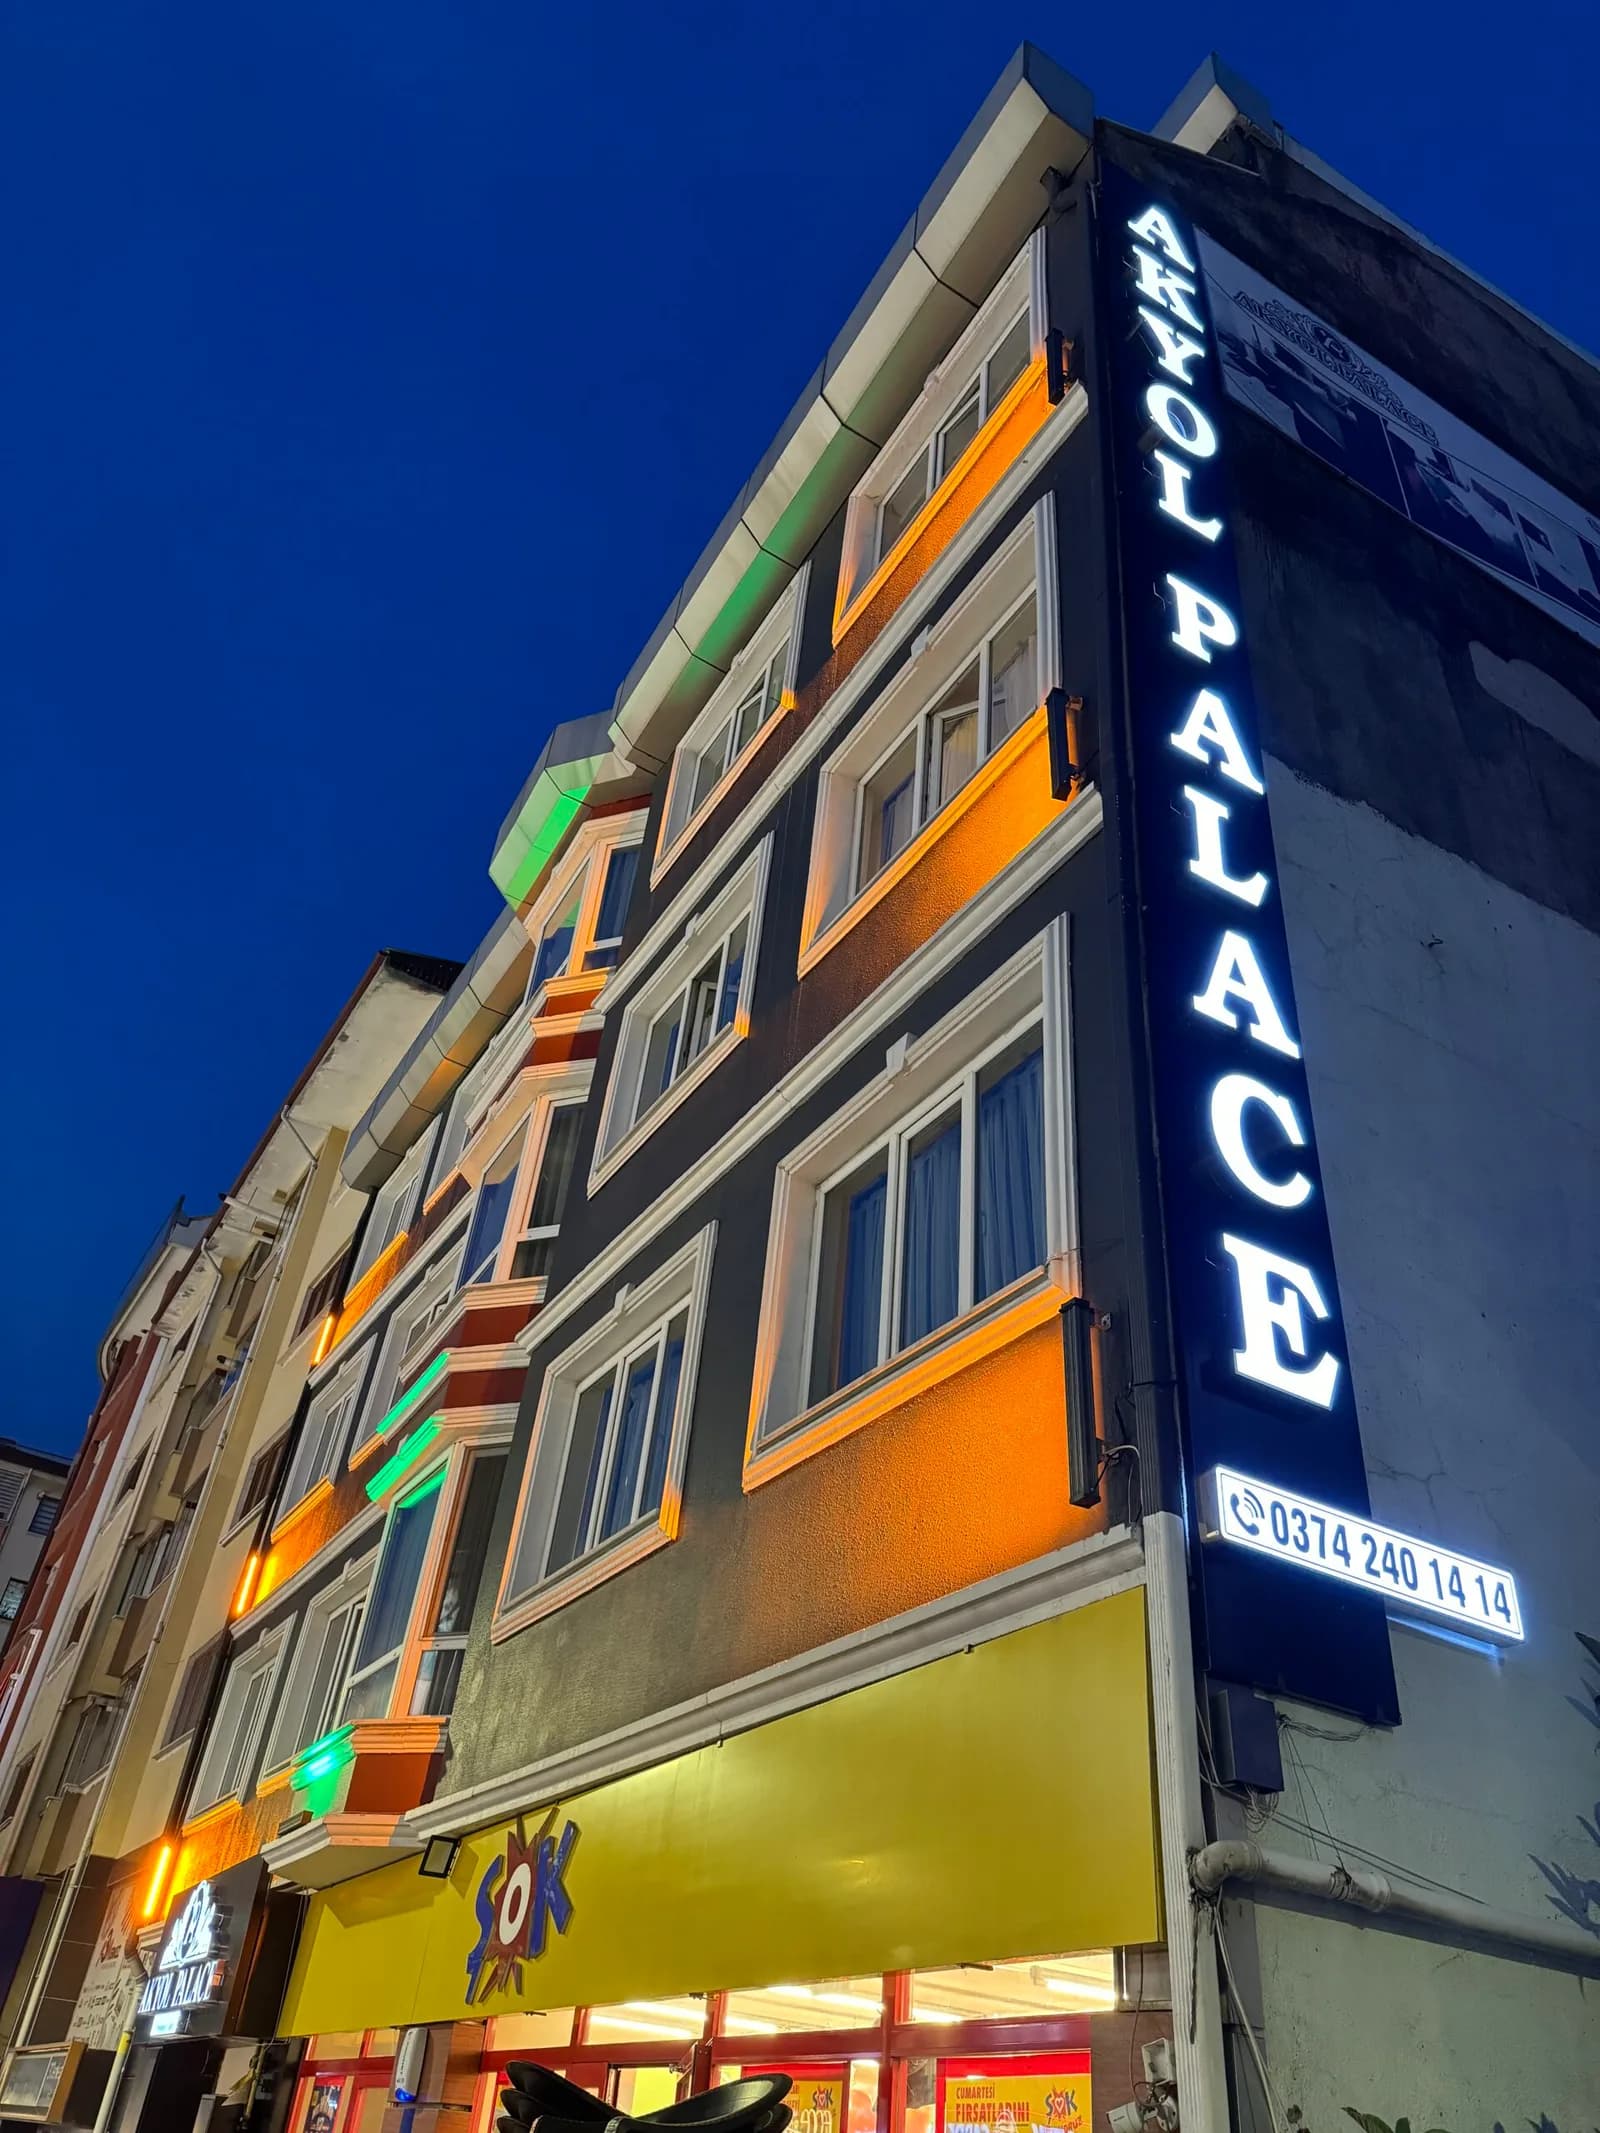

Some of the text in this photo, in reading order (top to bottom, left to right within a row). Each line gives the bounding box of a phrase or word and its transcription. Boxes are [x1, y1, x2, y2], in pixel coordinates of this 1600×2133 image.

[1127, 206, 1342, 1411] AKYOL PALACE
[1270, 1500, 1512, 1624] 0374 240 14 14
[137, 1971, 175, 2014] AKYOL
[956, 2083, 995, 2099] CUMARTESİ
